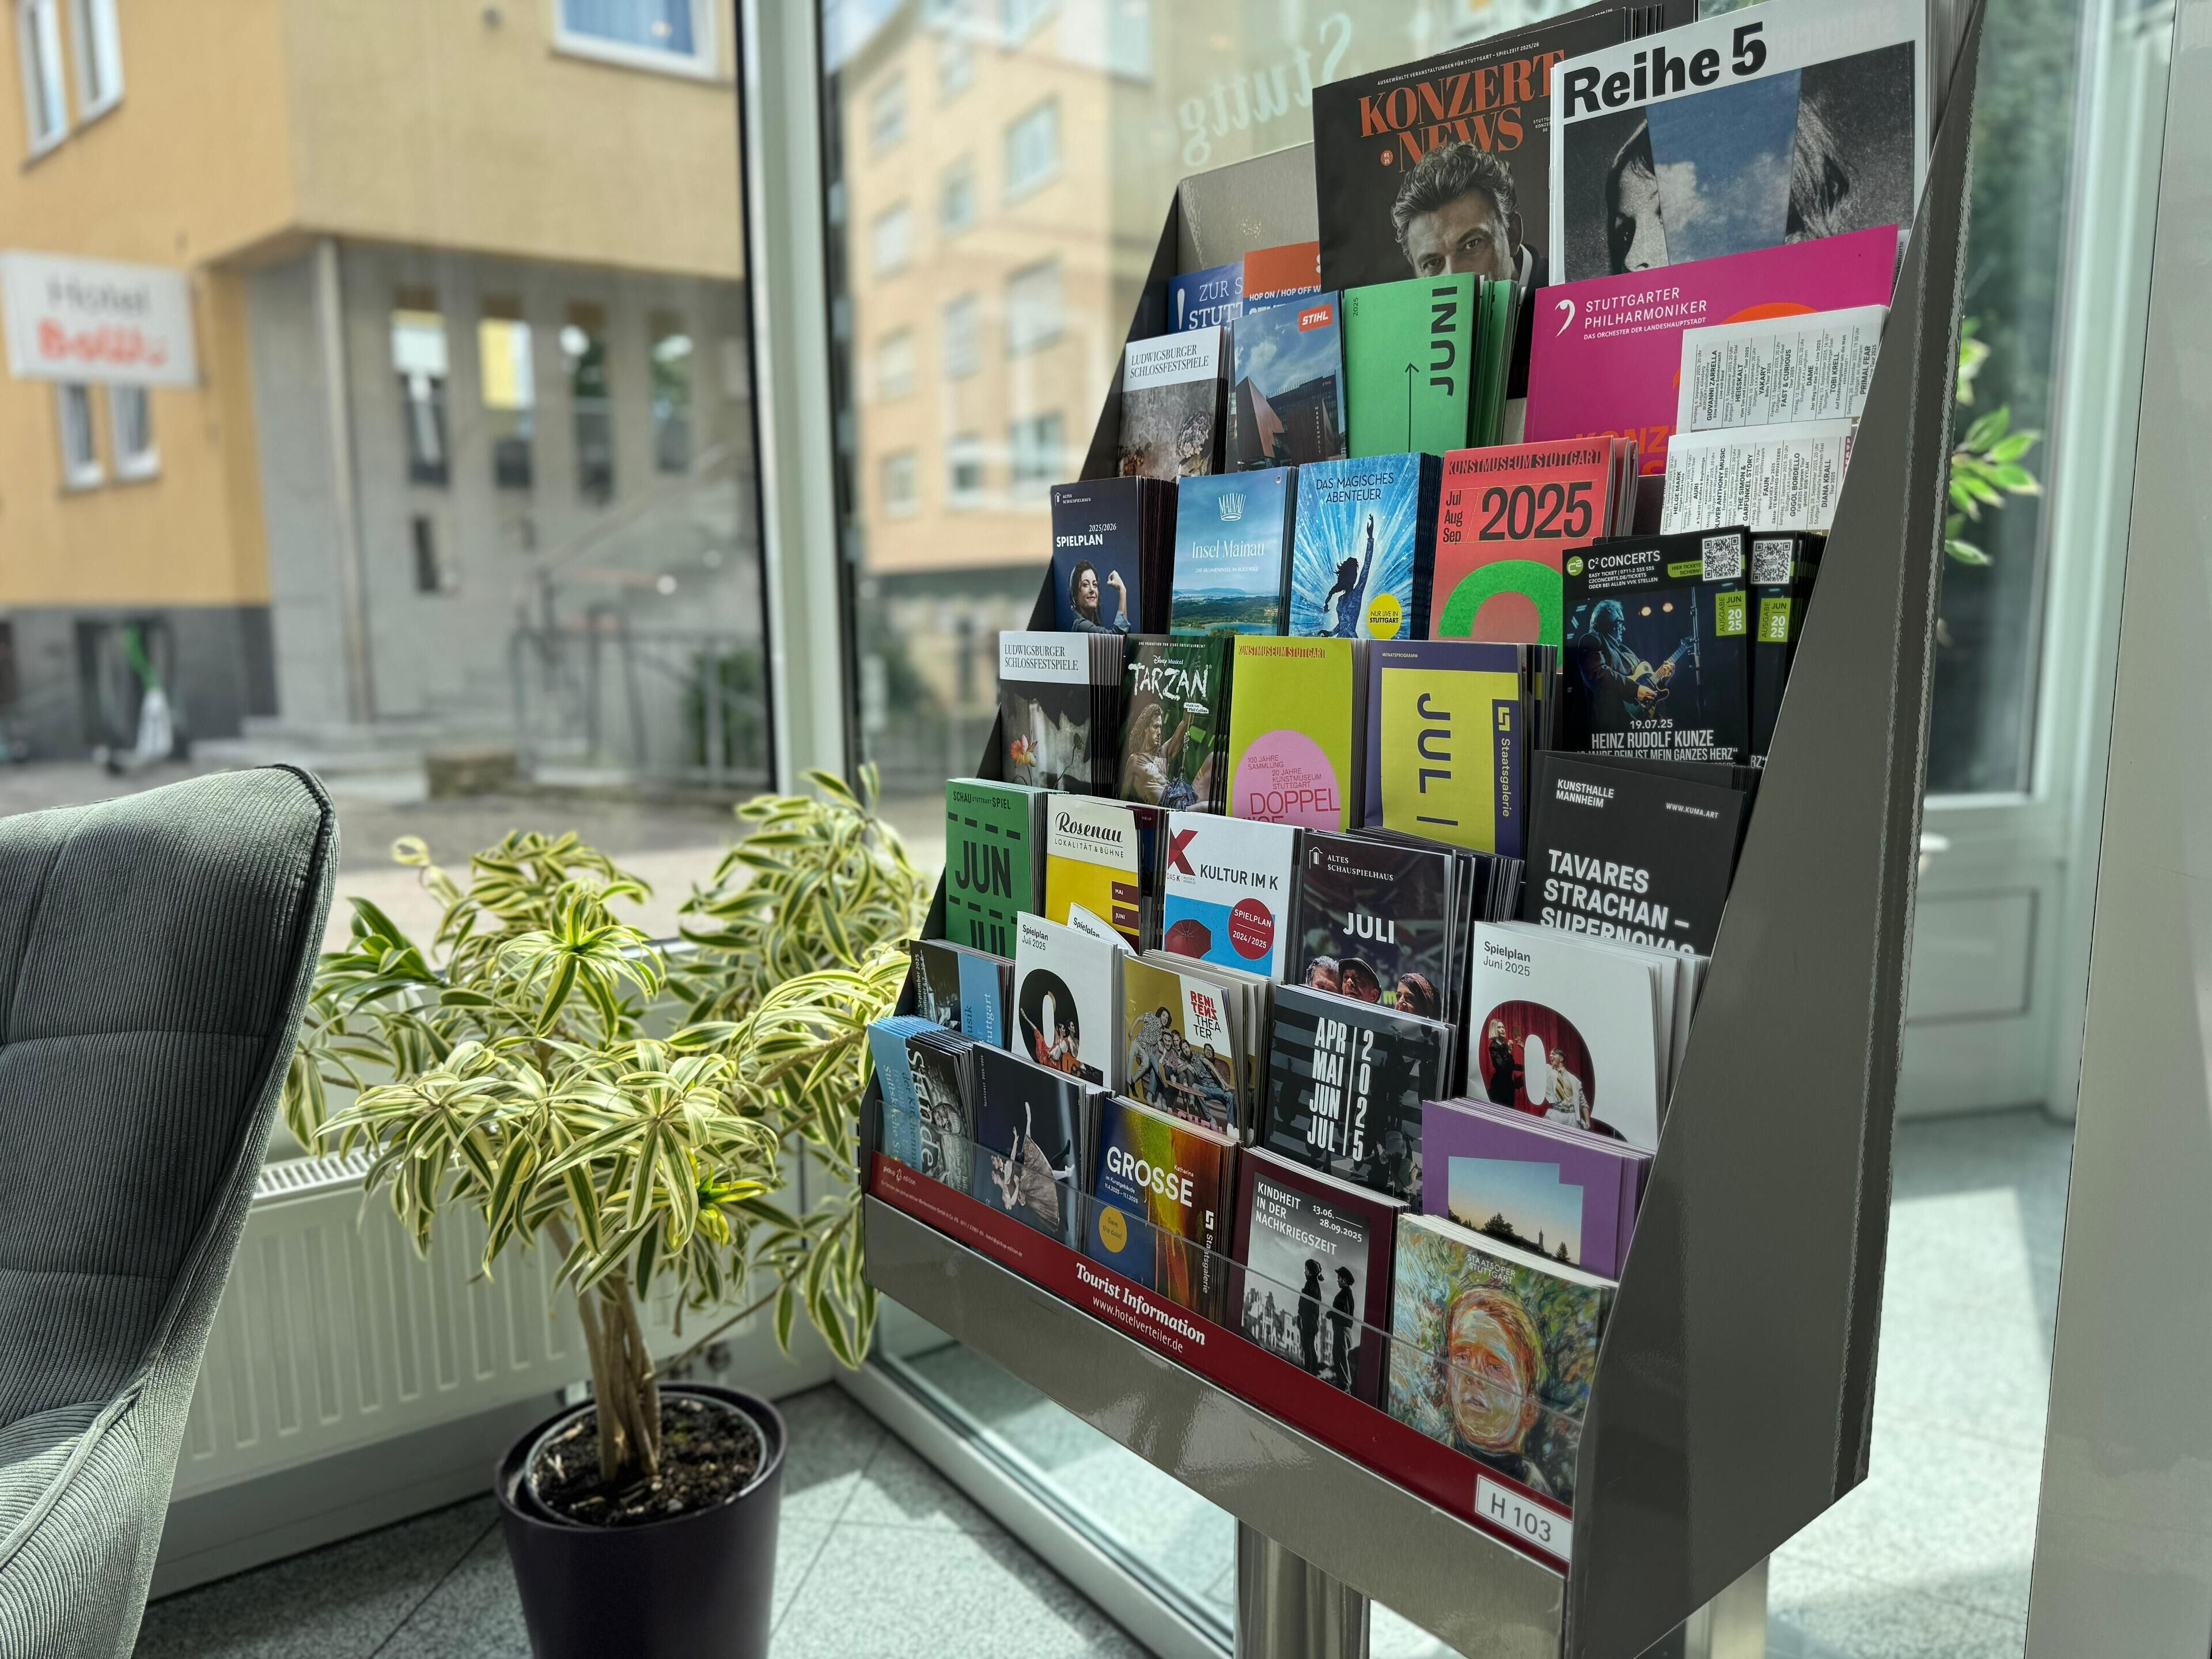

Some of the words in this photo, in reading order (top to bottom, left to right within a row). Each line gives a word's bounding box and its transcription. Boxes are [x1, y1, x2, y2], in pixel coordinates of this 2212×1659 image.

[1378, 73, 1409, 85] AUSGEWÄHLTE
[1410, 62, 1454, 78] VERANSTALTUNGEN
[1464, 54, 1491, 65] STUTTGART
[1497, 47, 1519, 57] SPIELZEIT
[1520, 42, 1539, 51] 2025/26
[1564, 47, 1719, 118] Reihe
[1732, 21, 1766, 77] 5
[1358, 50, 1564, 138] KONZERT
[1397, 107, 1522, 172] NEWS
[1199, 281, 1228, 302] ZUR
[1249, 293, 1263, 301] HOP
[1265, 290, 1275, 299] ON
[1281, 288, 1296, 297] HOP
[1297, 286, 1311, 295] OFF
[1586, 287, 1680, 313] STUTTGARTER
[1302, 310, 1328, 325] STIHL
[1585, 300, 1707, 328] PHILHARMONIKER
[1597, 328, 1630, 338] ORCHESTER
[1644, 317, 1706, 332] LANDESHAUPTSTADT
[1430, 285, 1458, 397] JUNI
[1131, 344, 1197, 366] LUDWIGSBURGER
[1130, 355, 1209, 378] SCHLOSSFESTSPIELE
[1735, 364, 1743, 402] HEISSKALT
[1860, 370, 1869, 395] PRIMAL
[1449, 454, 1532, 475] KUNSTMUSEUM
[1536, 450, 1601, 468] STUTTGART
[1316, 478, 1333, 490] DAS
[1336, 472, 1394, 488] MAGISCHES
[1218, 493, 1246, 515] MAINAU
[1325, 488, 1381, 503] ABENTEUER
[1446, 490, 1461, 506] Jul
[1444, 510, 1463, 527] Aug
[1479, 482, 1592, 541] 2025
[1089, 523, 1116, 532] 2025/2026
[1443, 528, 1461, 544] Sep
[1056, 534, 1103, 547] SPIELPLAN
[1192, 541, 1219, 559] Insel
[1222, 539, 1264, 558] Mainau
[1601, 550, 1660, 568] CONCERTS
[1589, 573, 1646, 584] C2CONCERTS.DE/TICKETS
[1726, 596, 1742, 604] JUN
[1728, 609, 1742, 620] 20
[1728, 620, 1742, 631] 25
[1005, 644, 1065, 657] LUDWIGSBURGER
[1238, 645, 1286, 657] KUNSTMUSEUM
[1287, 646, 1325, 658] STUTTGART
[1005, 657, 1078, 671] SCHLOSSFESTSPIELE
[1128, 662, 1208, 701] TARZAN
[1630, 719, 1673, 729] 19.07.25
[1592, 733, 1624, 749] HEINZ
[1627, 731, 1671, 748] RUDOLF
[1675, 730, 1714, 747] KUNZE
[1259, 755, 1278, 763] JAHRE
[1416, 692, 1459, 826] JULI
[1635, 749, 1648, 759] IST
[1650, 749, 1671, 760] MEIN
[1674, 748, 1707, 761] GANZES
[1248, 762, 1283, 770] SAMMLUNG
[1272, 774, 1321, 782] KUNSTMUSEUM
[1273, 781, 1310, 790] STUTTGART
[1500, 738, 1512, 817] Staatsgalerie
[1557, 779, 1615, 798] KUNSTHALLE
[953, 791, 972, 804] SCHAU
[992, 797, 1010, 809] SPIEL
[1250, 788, 1340, 815] DOPPEL
[1556, 790, 1604, 808] MANNHEIM
[1666, 803, 1719, 819] WWW.KUMA.ART
[1055, 812, 1123, 842] Rosenau
[1055, 838, 1092, 851] LOKALITÄT
[1100, 846, 1124, 858] BÜHNE
[1327, 854, 1349, 863] ALTES
[955, 840, 1012, 899] JUN
[1167, 873, 1176, 881] DAS
[1200, 864, 1247, 885] KULTUR
[1251, 873, 1266, 888] IM
[1270, 876, 1279, 890] K
[1327, 864, 1393, 881] SCHAUSPIELHAUS
[1548, 849, 1650, 894] TAVARES
[1543, 878, 1669, 930] STRACHAN
[1073, 917, 1100, 938] Spielplan
[1234, 909, 1271, 927] SPIELPLAN
[1343, 912, 1394, 944] JULI
[1022, 925, 1048, 940] Spielplan
[1022, 937, 1032, 946] Juli
[1032, 940, 1046, 950] 2025
[1484, 941, 1531, 963] Spielplan
[1483, 956, 1502, 969] Juni
[1505, 961, 1531, 976] 2025
[1190, 990, 1214, 1005] RENI
[1193, 1024, 1213, 1040] TER
[1195, 1014, 1221, 1033] THEA
[1315, 1017, 1347, 1055] APR
[1312, 1049, 1344, 1087] MAI
[1309, 1082, 1341, 1120] JUN
[1307, 1115, 1335, 1153] JUL
[1107, 1146, 1193, 1207] GROSSE
[1174, 1164, 1194, 1177] Katharina
[1257, 1181, 1301, 1210] KINDHEIT
[1256, 1196, 1266, 1210] IN
[1268, 1200, 1286, 1219] DER
[1312, 1205, 1334, 1219] 13.06.
[1108, 1217, 1118, 1227] Save
[1319, 1218, 1362, 1243] 28.09.2025
[1111, 1229, 1122, 1240] date!
[1255, 1210, 1337, 1255] NACHKRIEGSZEIT
[1202, 1233, 1213, 1293] Staatsgalerie
[1467, 1253, 1516, 1278] STAATSOPER
[1469, 1263, 1513, 1284] STUTTGART
[1076, 1262, 1120, 1300] Tourist
[1123, 1287, 1206, 1346] Information
[1093, 1295, 1184, 1354] www.hotelverteiler.de
[1490, 1492, 1506, 1520] H
[1513, 1506, 1552, 1543] 103
